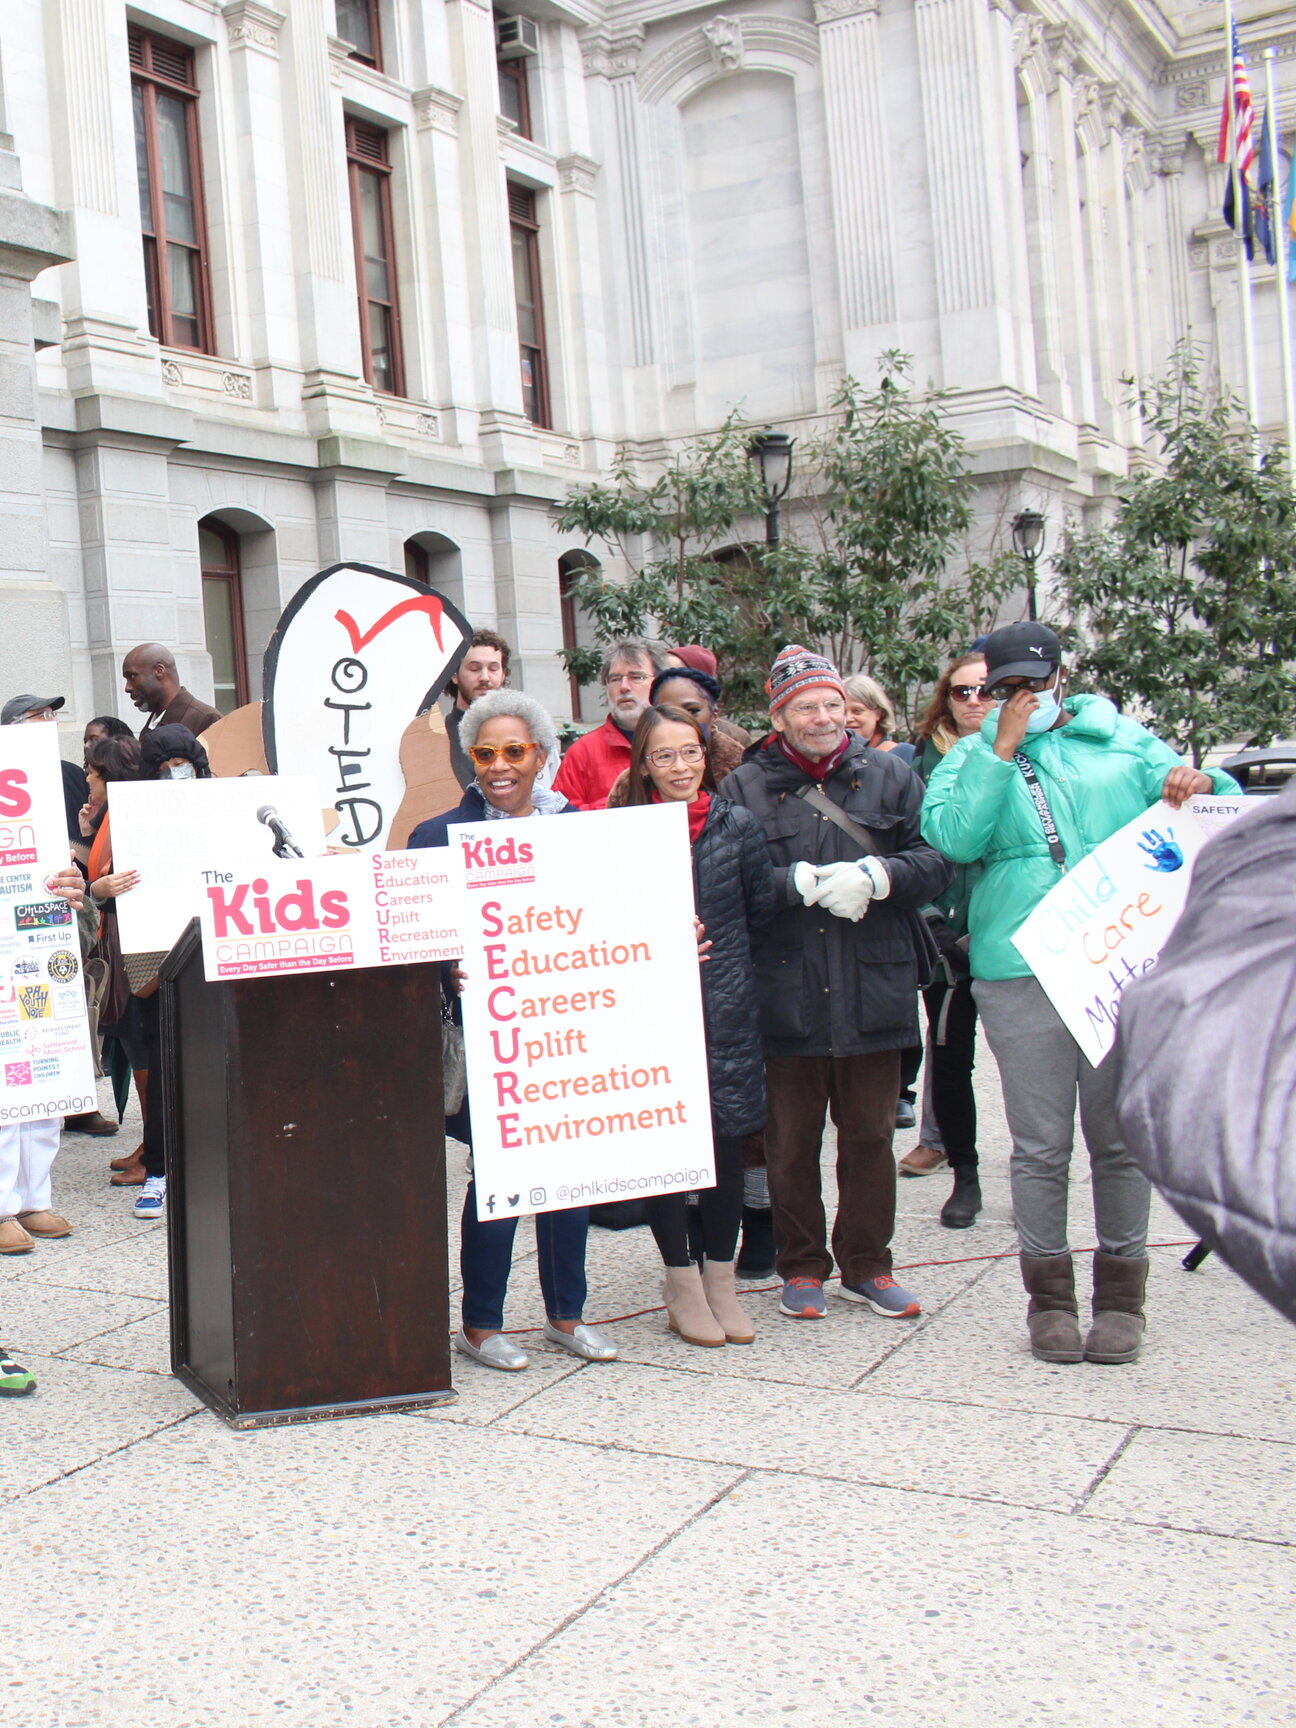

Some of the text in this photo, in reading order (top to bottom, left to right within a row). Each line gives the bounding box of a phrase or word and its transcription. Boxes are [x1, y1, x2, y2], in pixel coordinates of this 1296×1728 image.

[1192, 805, 1240, 815] SAFETY
[6, 852, 35, 863] Before
[372, 854, 418, 871] Safety
[461, 837, 533, 869] Kids
[6, 874, 31, 882] CENTER
[202, 870, 233, 884] The
[373, 873, 449, 888] Education
[465, 865, 535, 882] CAMPAIGN
[0, 884, 33, 895] AUTISM
[375, 891, 433, 907] Careers
[207, 878, 350, 938] Kids
[1038, 851, 1119, 955] Child
[376, 909, 420, 927] Uplift
[481, 901, 583, 937] Safety
[36, 931, 72, 943] First Up
[378, 928, 458, 943] Recreation
[216, 934, 353, 962] CAMPAIGN
[379, 944, 464, 962] Enviroment
[219, 955, 352, 975] Every Day Safer than the Day Before
[483, 940, 651, 980] Education
[488, 985, 616, 1022] Careers
[1084, 947, 1164, 1050] Matte
[490, 1027, 587, 1068] Uplift
[493, 1063, 671, 1107] Recreation
[496, 1100, 687, 1149] Enviroment
[556, 1167, 710, 1202] @phlkidscampaign
